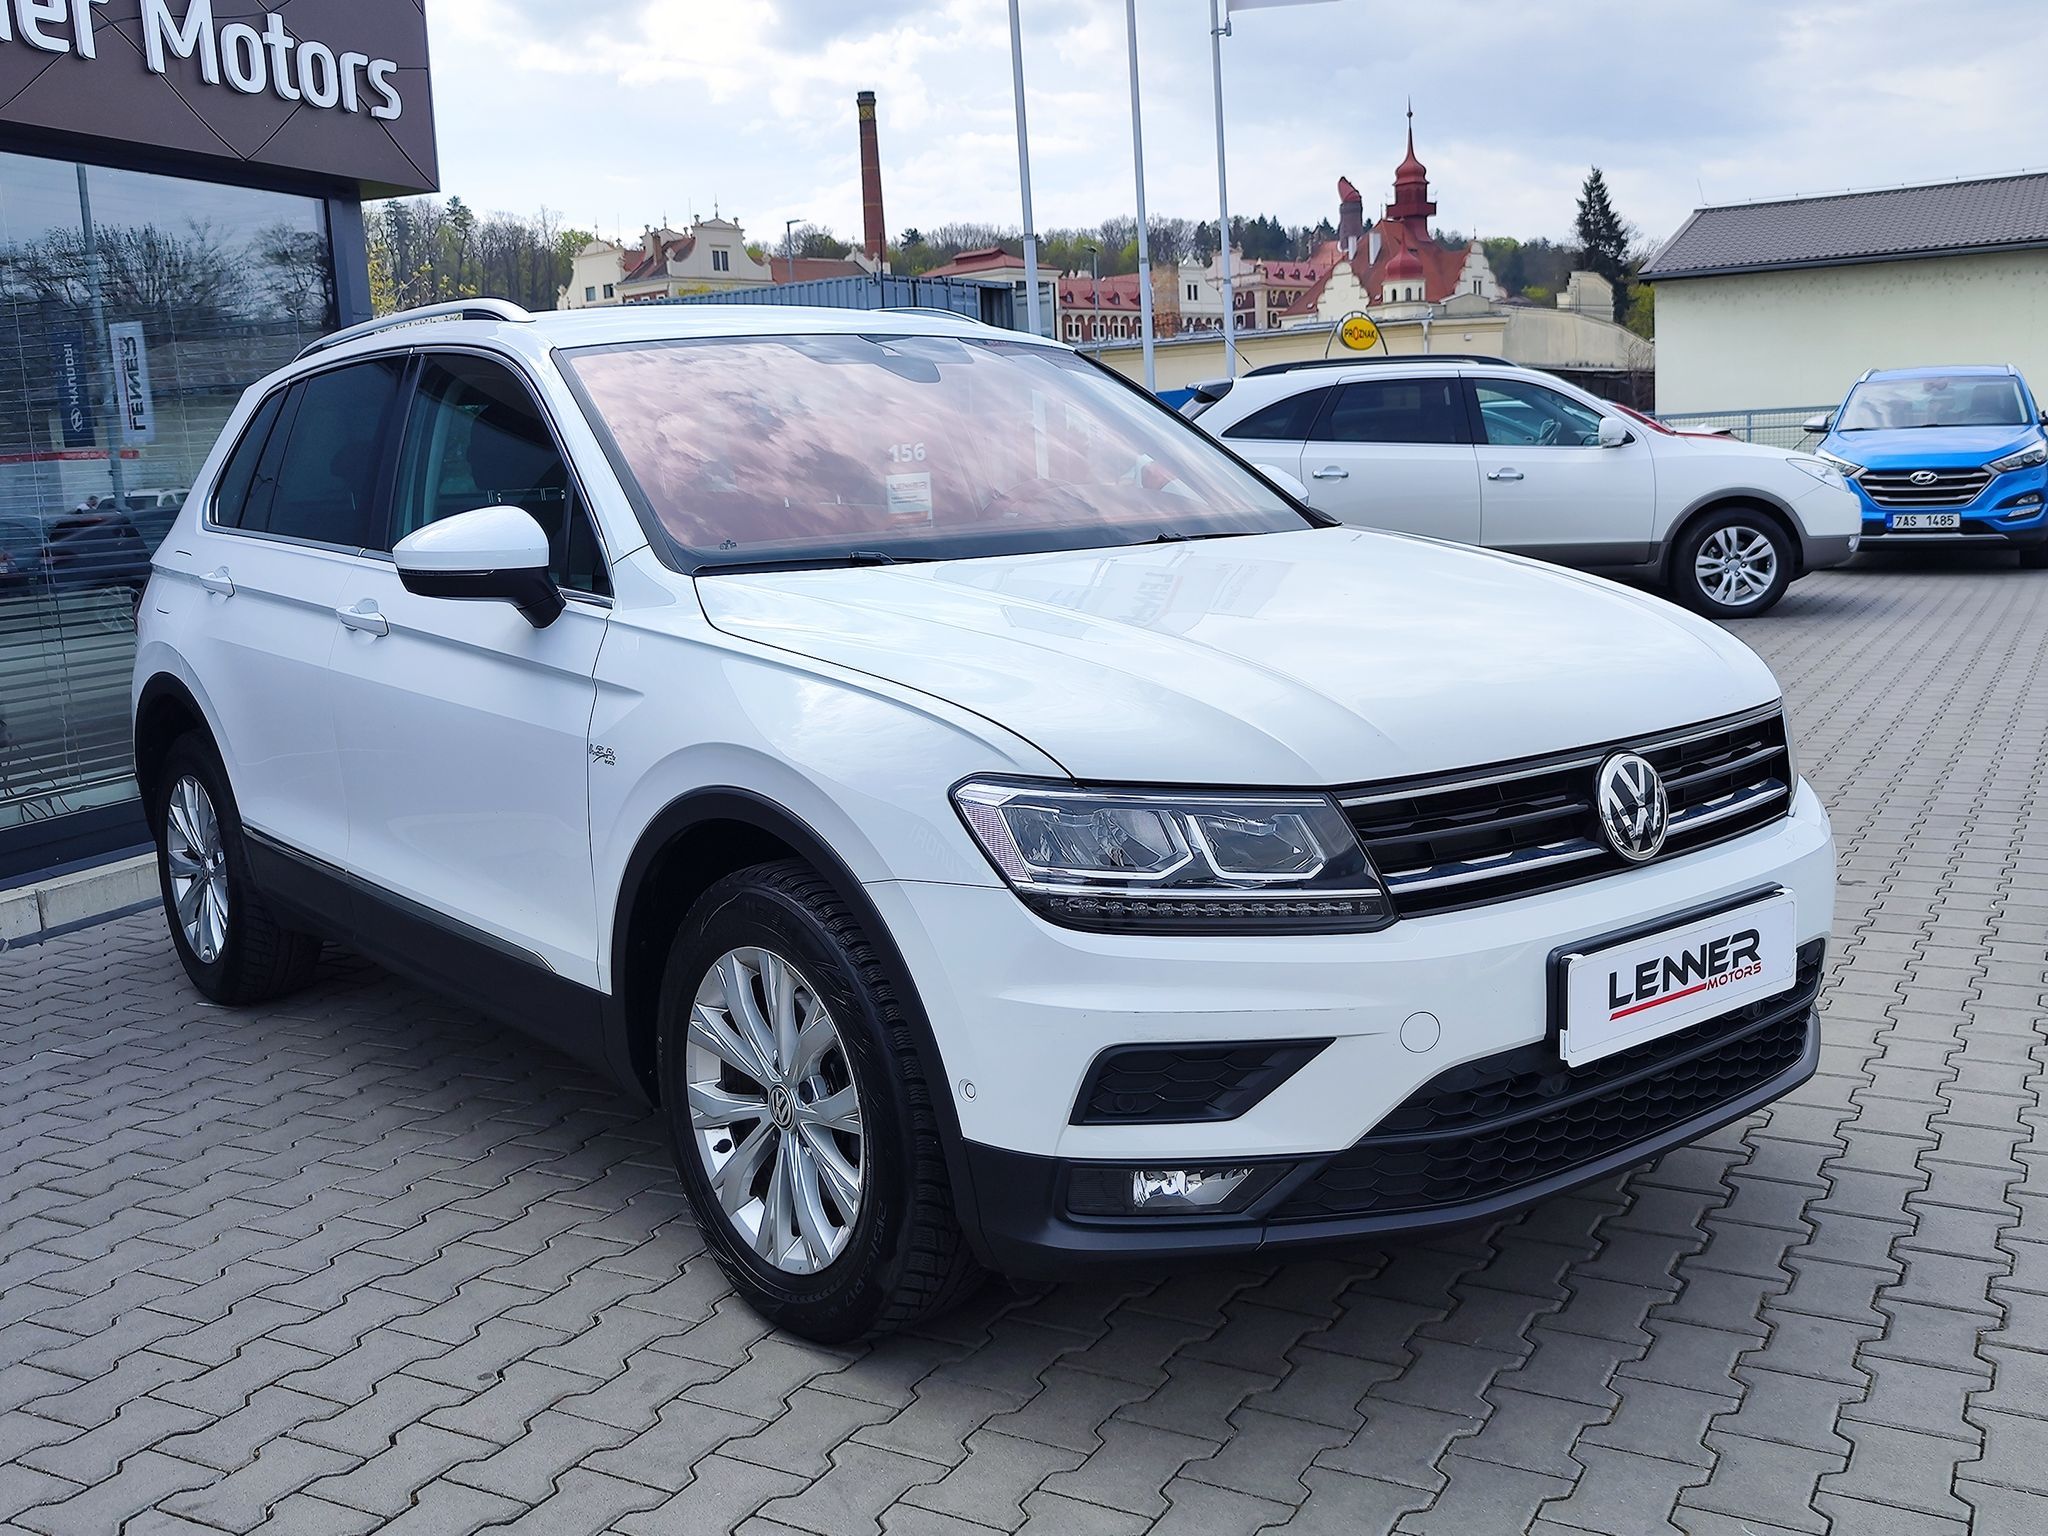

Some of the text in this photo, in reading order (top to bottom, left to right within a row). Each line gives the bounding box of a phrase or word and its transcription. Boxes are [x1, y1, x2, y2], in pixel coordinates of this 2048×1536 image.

[141, 0, 402, 120] Motors
[888, 442, 927, 462] 156
[1895, 515, 1917, 527] 7AS
[1926, 514, 1954, 526] 1485
[1608, 928, 1762, 1010] LENNER
[1706, 961, 1762, 990] MOTORS
